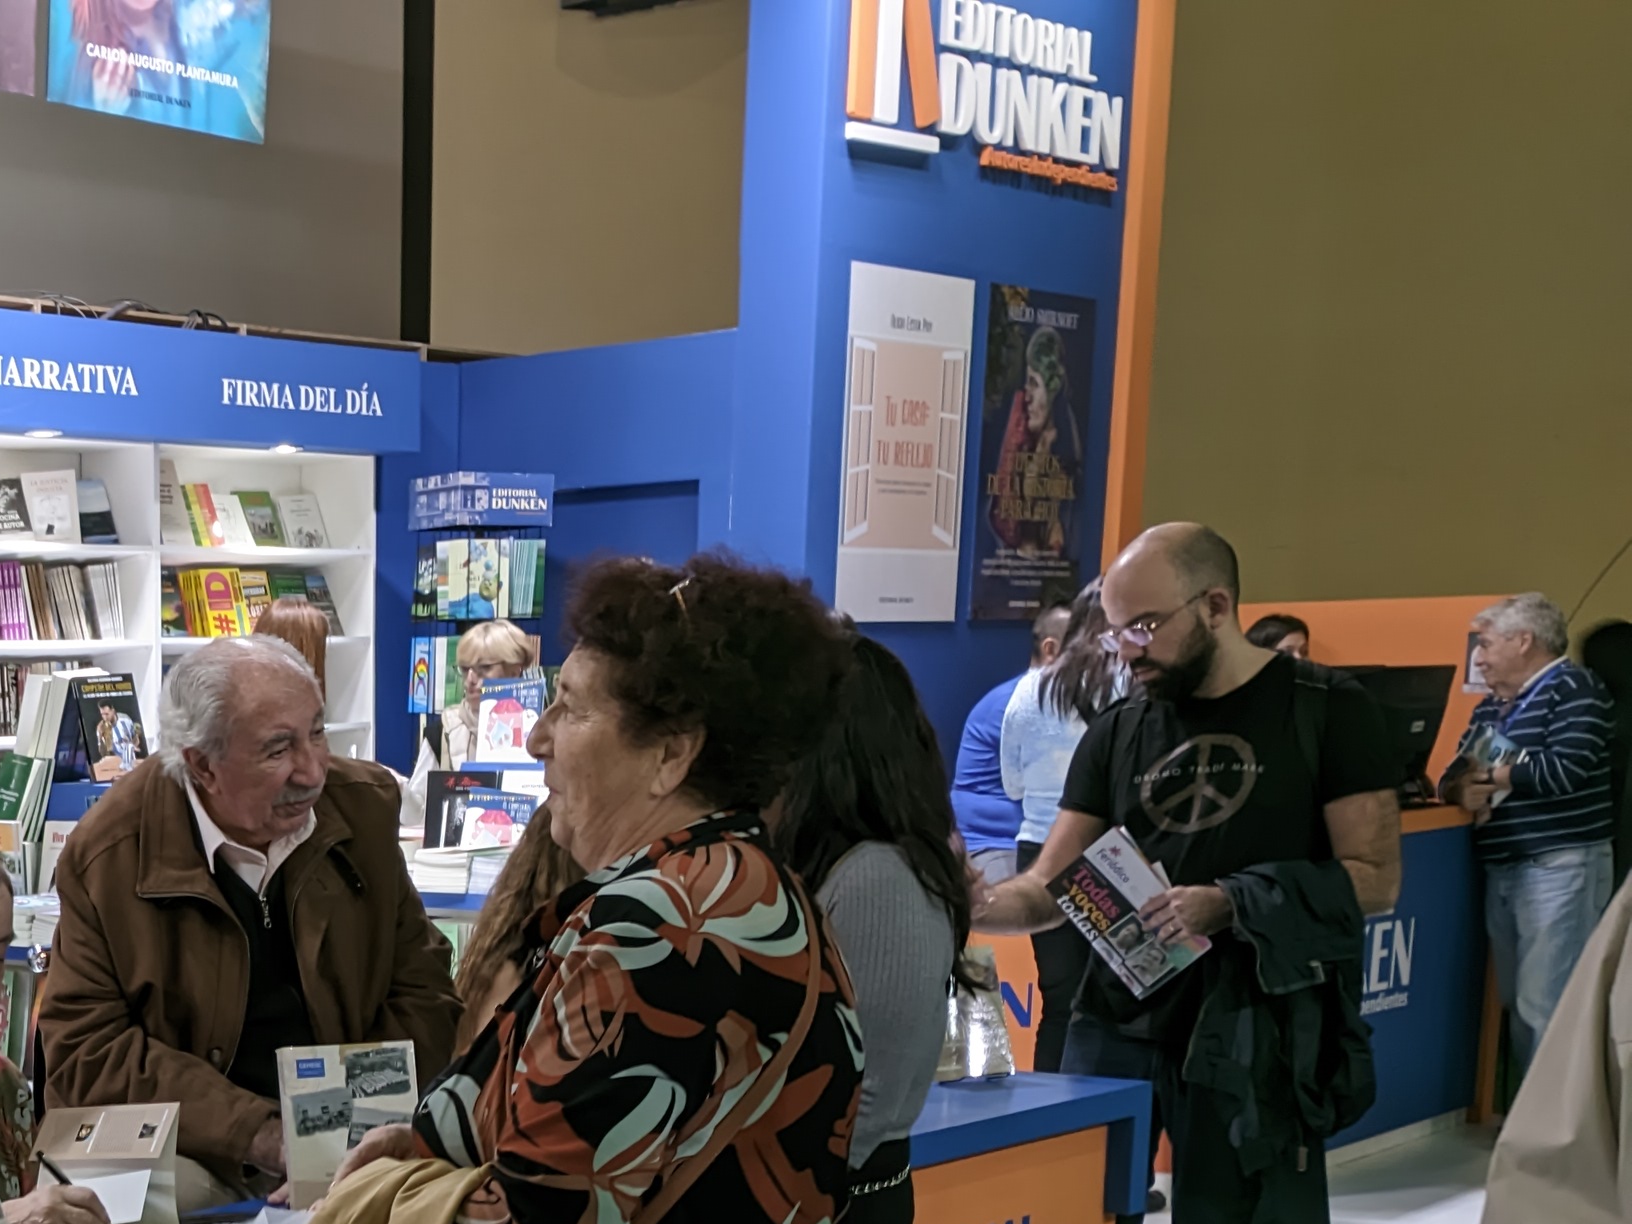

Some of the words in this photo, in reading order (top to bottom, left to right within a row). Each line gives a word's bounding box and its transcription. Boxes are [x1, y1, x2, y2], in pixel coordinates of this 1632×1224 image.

[86, 42, 127, 64] CARLOS
[128, 51, 174, 75] AUGUSTO
[175, 61, 239, 90] PLANTAMURA
[939, 0, 1098, 83] EDITORIAL
[938, 52, 1123, 170] DUNKEN
[221, 377, 296, 410] FIRMA
[299, 385, 344, 414] DEL
[346, 382, 383, 417] DÍA
[491, 498, 548, 510] DUNKEN
[492, 487, 537, 498] EDITORIAL
[1056, 893, 1101, 942] todas
[1069, 883, 1112, 932] voces
[1072, 867, 1120, 919] Todas
[1363, 917, 1416, 994] EN
